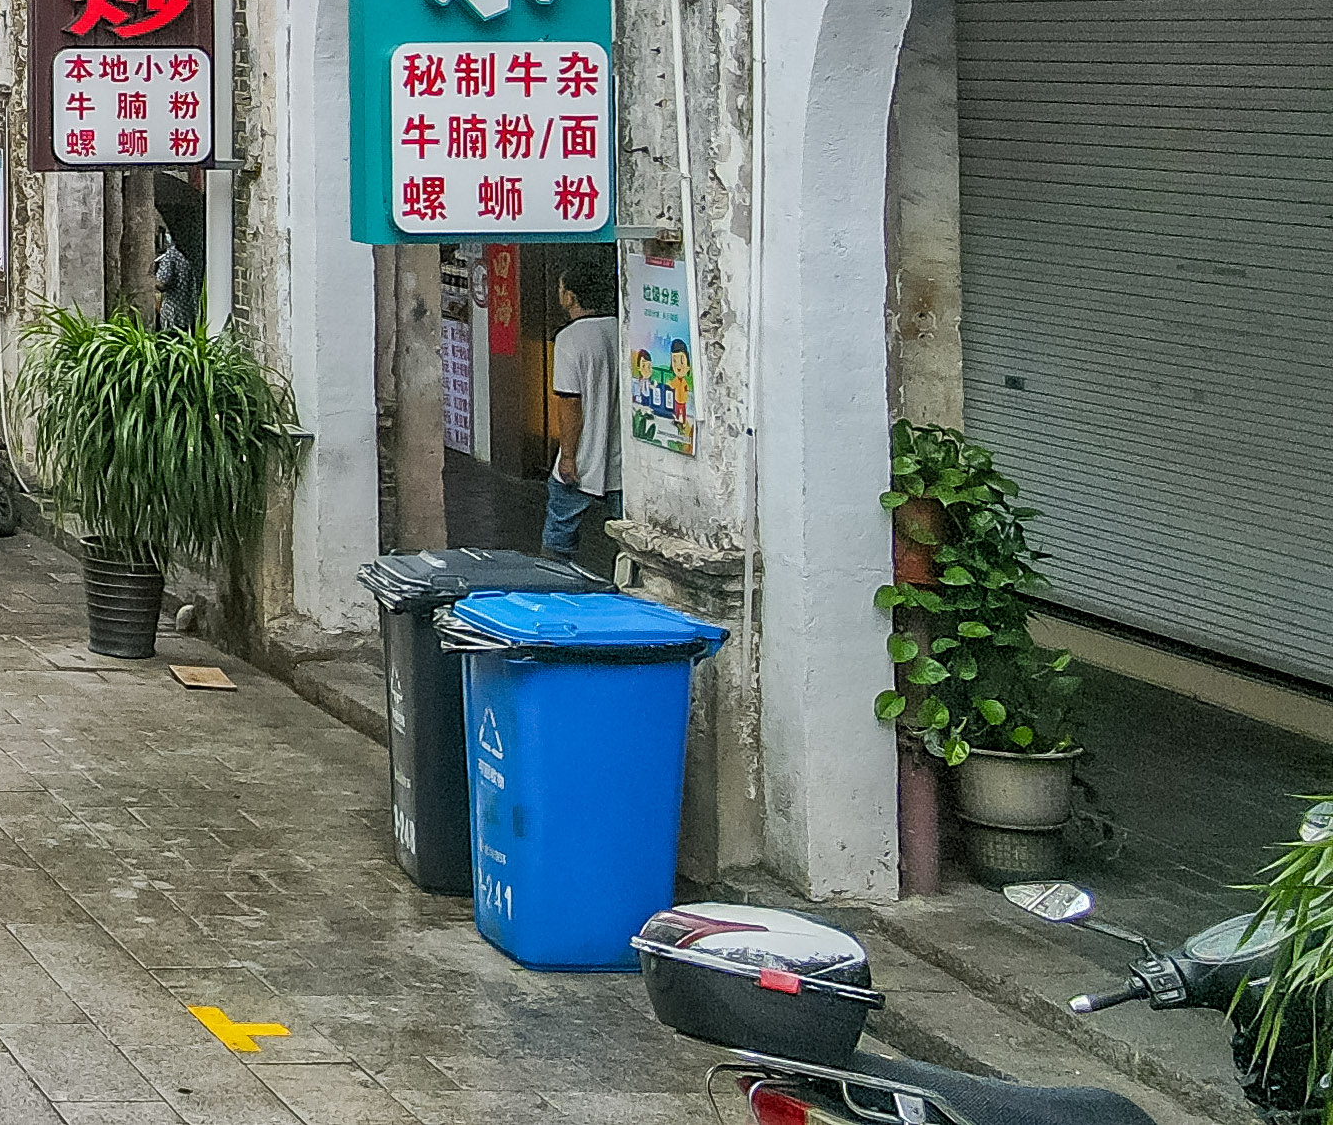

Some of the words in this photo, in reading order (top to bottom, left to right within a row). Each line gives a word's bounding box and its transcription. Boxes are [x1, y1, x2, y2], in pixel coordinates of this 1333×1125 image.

[65, 54, 200, 83] 本地小炒
[403, 52, 599, 98] 秘制牛杂
[65, 91, 200, 121] 牛腩粉
[65, 128, 200, 158] 螺蛳粉
[401, 113, 597, 160] 牛腩粉/面
[402, 175, 599, 222] 螺蛳粉
